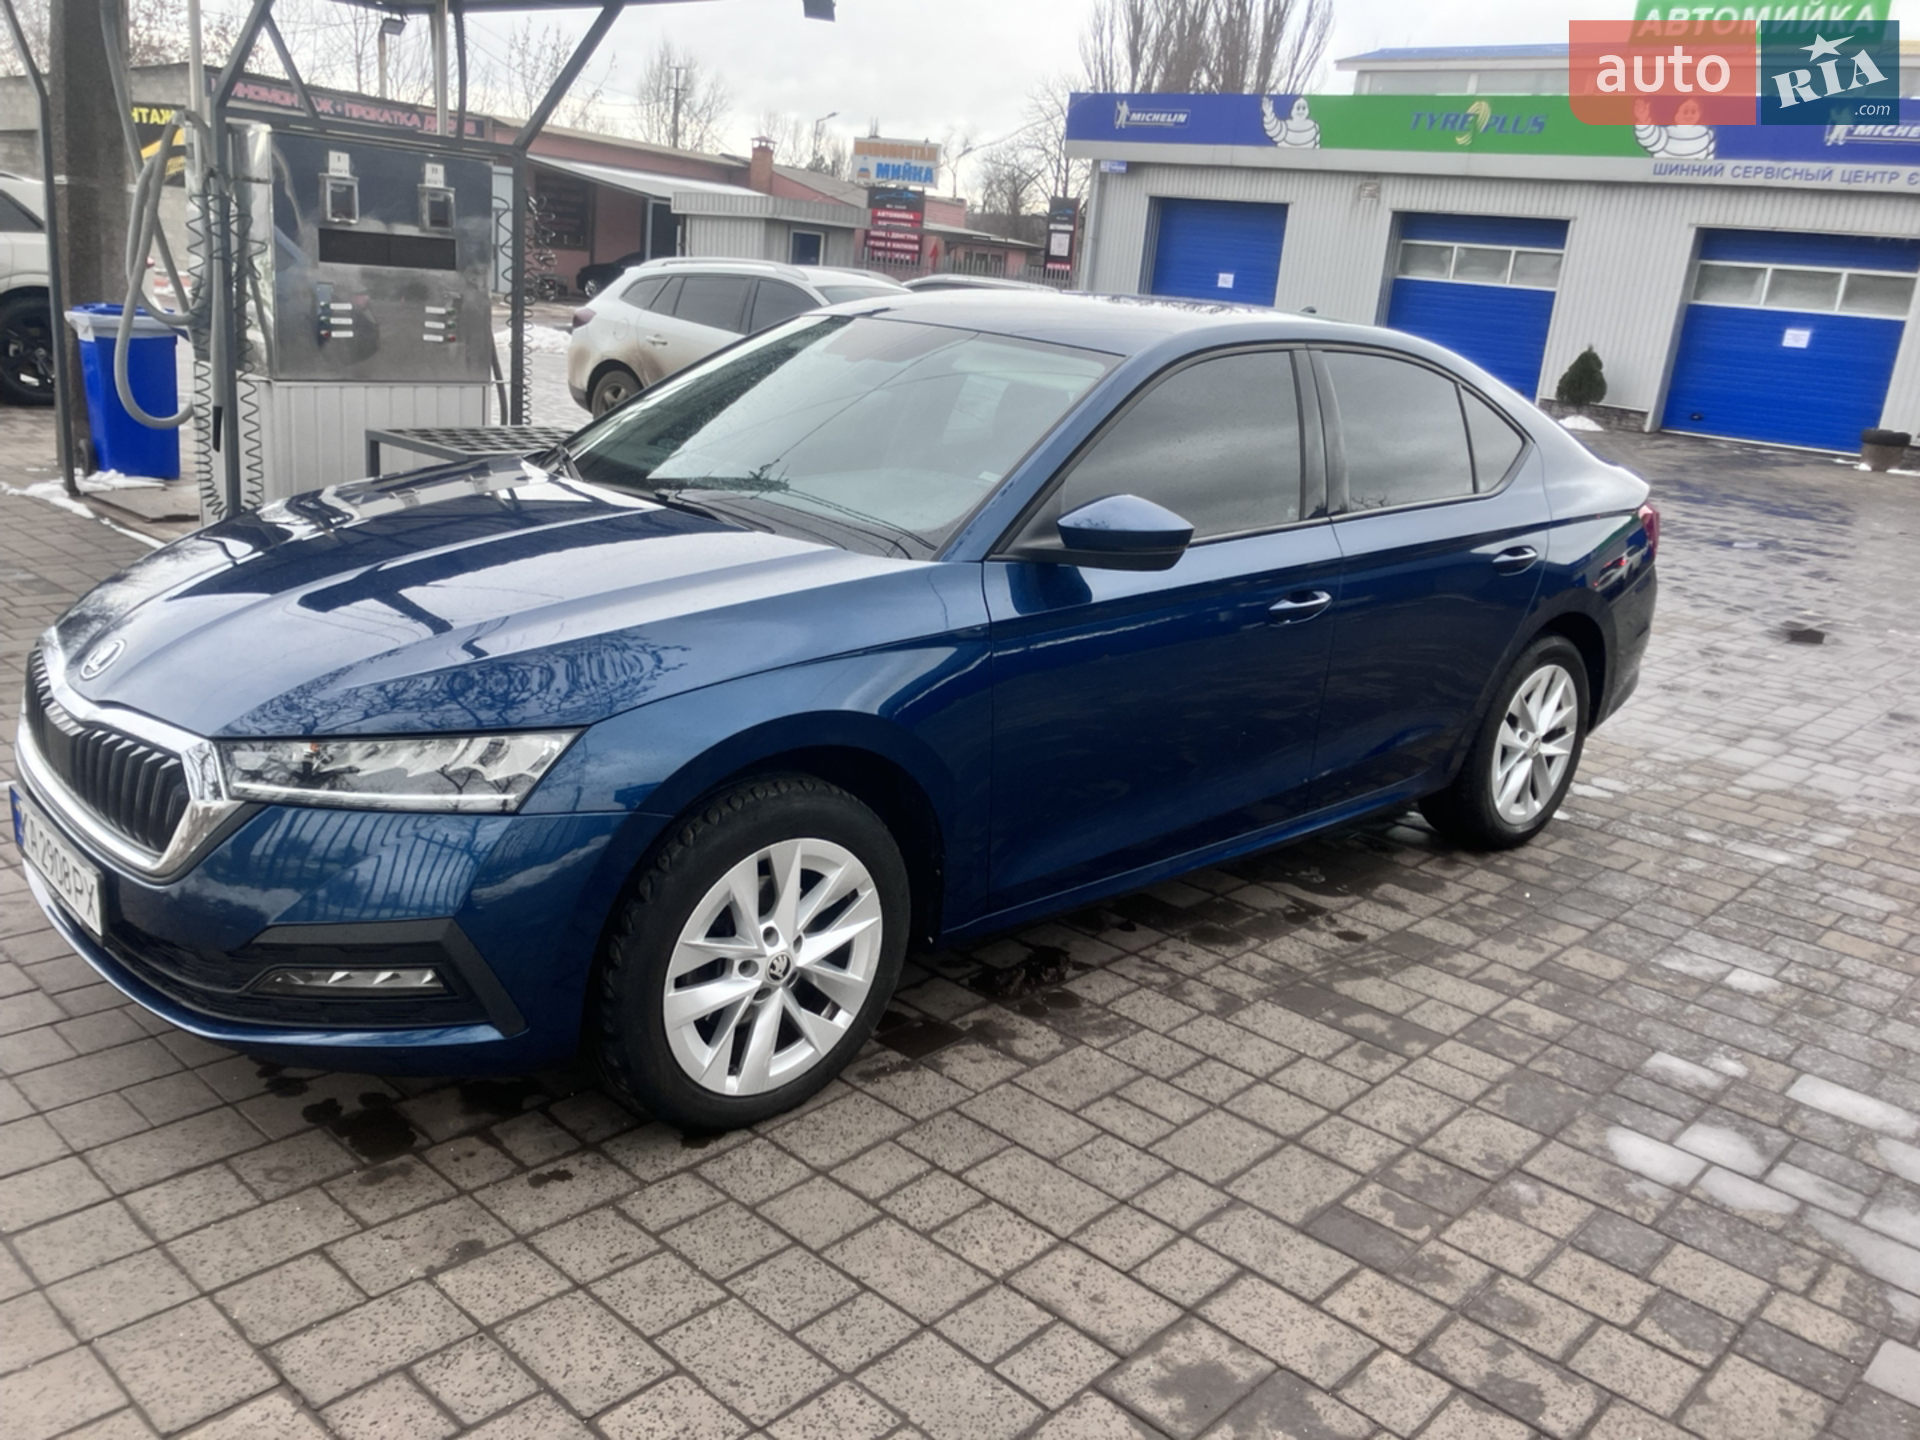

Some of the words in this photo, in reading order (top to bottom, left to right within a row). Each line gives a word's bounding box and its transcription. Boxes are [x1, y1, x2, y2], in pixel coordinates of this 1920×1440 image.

[1636, 0, 1876, 36] АВТОМИЙКА
[1130, 112, 1188, 123] MICHELIN
[1410, 112, 1475, 131] TYRE
[1481, 114, 1548, 135] PLUS
[876, 162, 934, 184] МИЙКА
[1652, 162, 1725, 178] ШИННИЙ
[1730, 165, 1834, 182] СЕРВІСНЫЙ
[1840, 170, 1901, 186] ЦЕНТР
